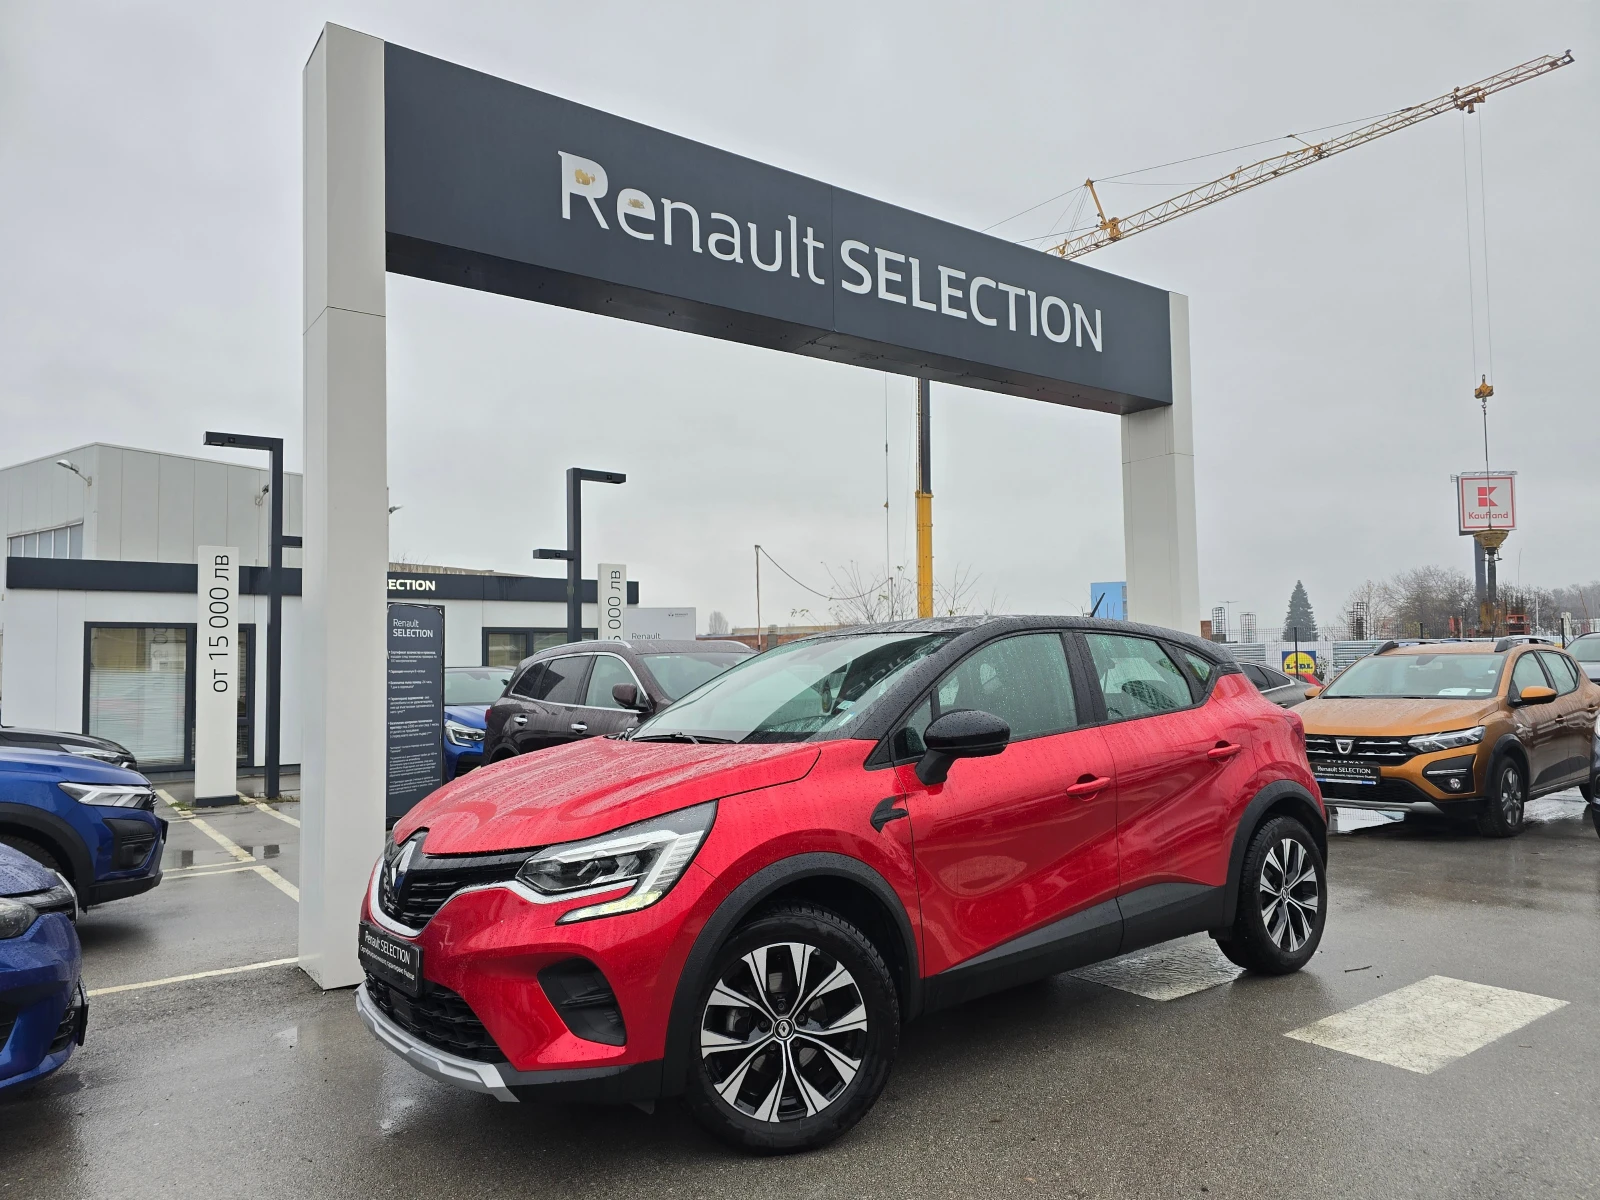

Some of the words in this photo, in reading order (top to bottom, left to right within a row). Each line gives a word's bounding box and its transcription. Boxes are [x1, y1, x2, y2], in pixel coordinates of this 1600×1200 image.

[557, 150, 825, 285] Renault
[840, 239, 1103, 353] SELECTION
[1468, 511, 1509, 520] Kaufand
[214, 554, 230, 582] лв
[386, 578, 436, 591] ECTION
[208, 587, 230, 629] 000
[607, 596, 622, 630] 000
[392, 618, 420, 628] Renault
[392, 628, 434, 638] SELECTION
[208, 635, 229, 661] 15
[631, 632, 662, 640] Renault
[213, 668, 228, 693] от
[1317, 765, 1338, 773] Renault
[380, 939, 411, 965] SELECTION
